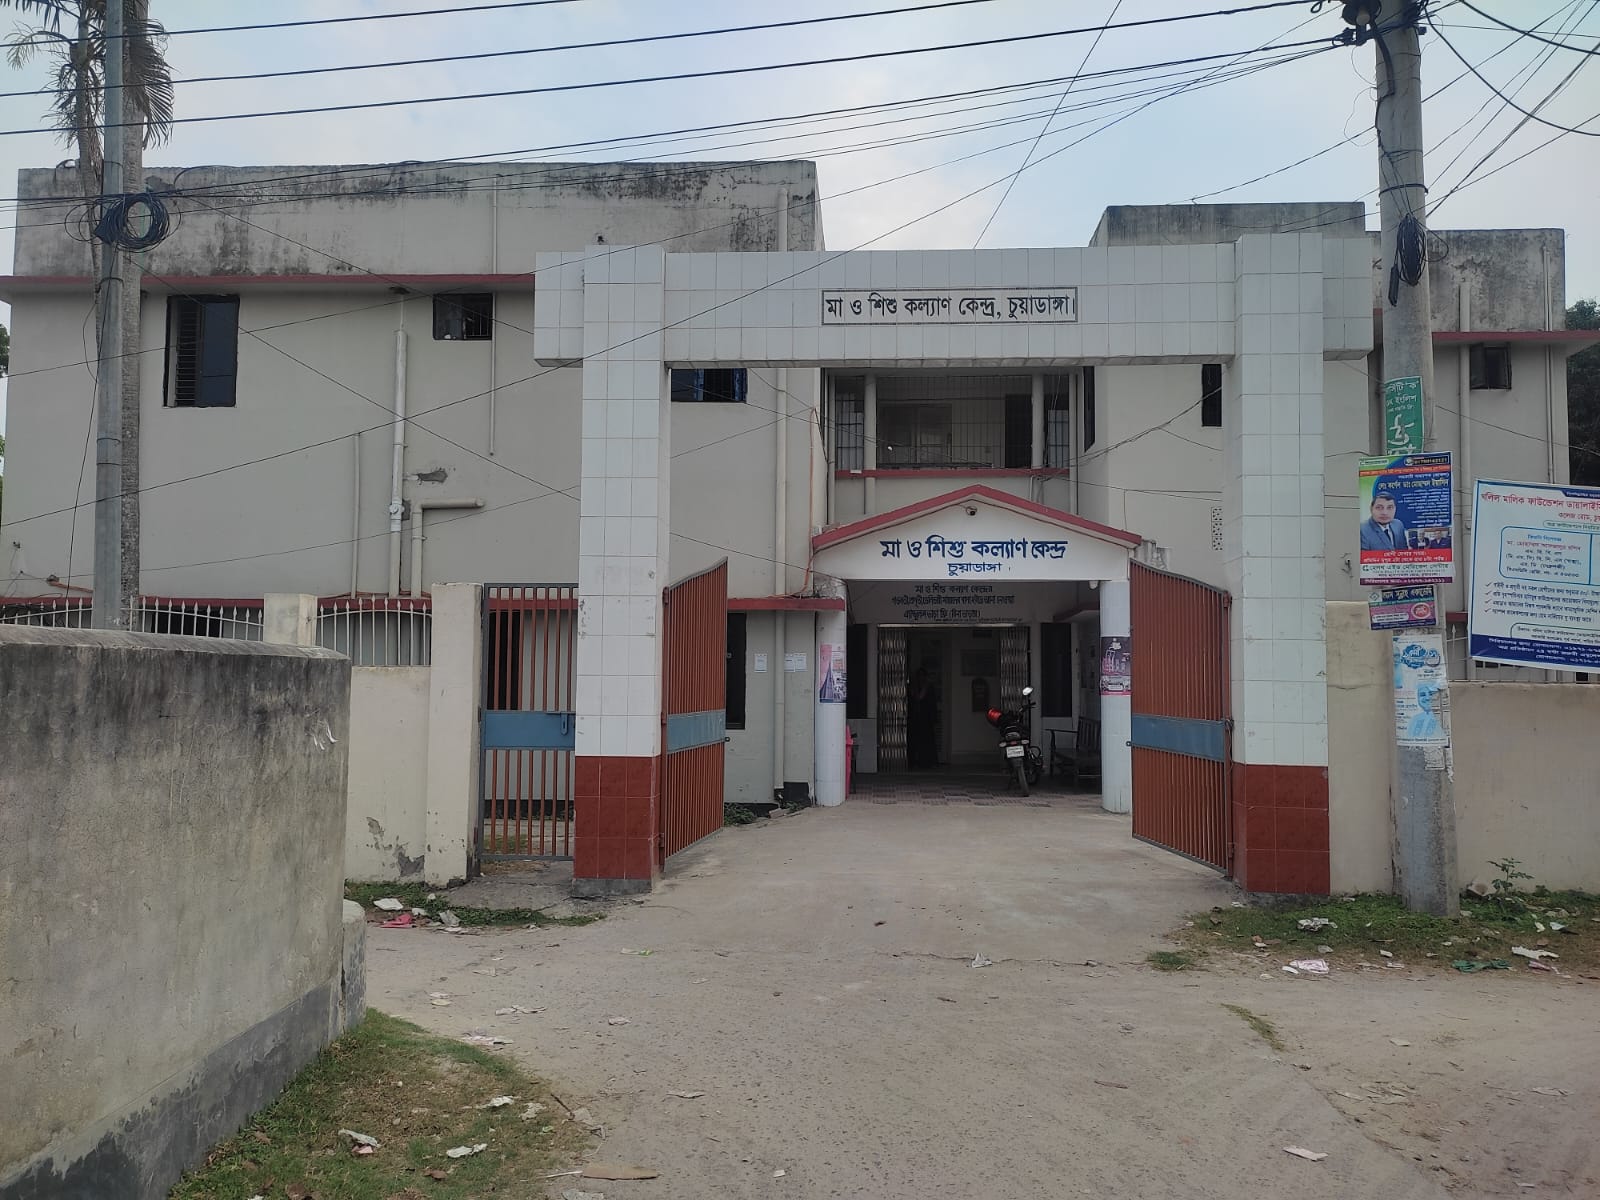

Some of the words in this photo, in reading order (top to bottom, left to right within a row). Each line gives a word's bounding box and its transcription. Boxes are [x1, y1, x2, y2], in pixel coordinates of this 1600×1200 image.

[825, 297, 843, 318] মা
[850, 298, 862, 316] ও
[868, 292, 898, 316] শিশু
[903, 296, 952, 317] কল্যাণ
[959, 297, 1002, 319] কেন্দ্র,
[880, 538, 901, 558] মা
[907, 539, 922, 558] ও
[925, 534, 967, 558] শিশু
[970, 537, 1028, 559] কল্যাণ
[1031, 540, 1068, 559] কেন্দ্র
